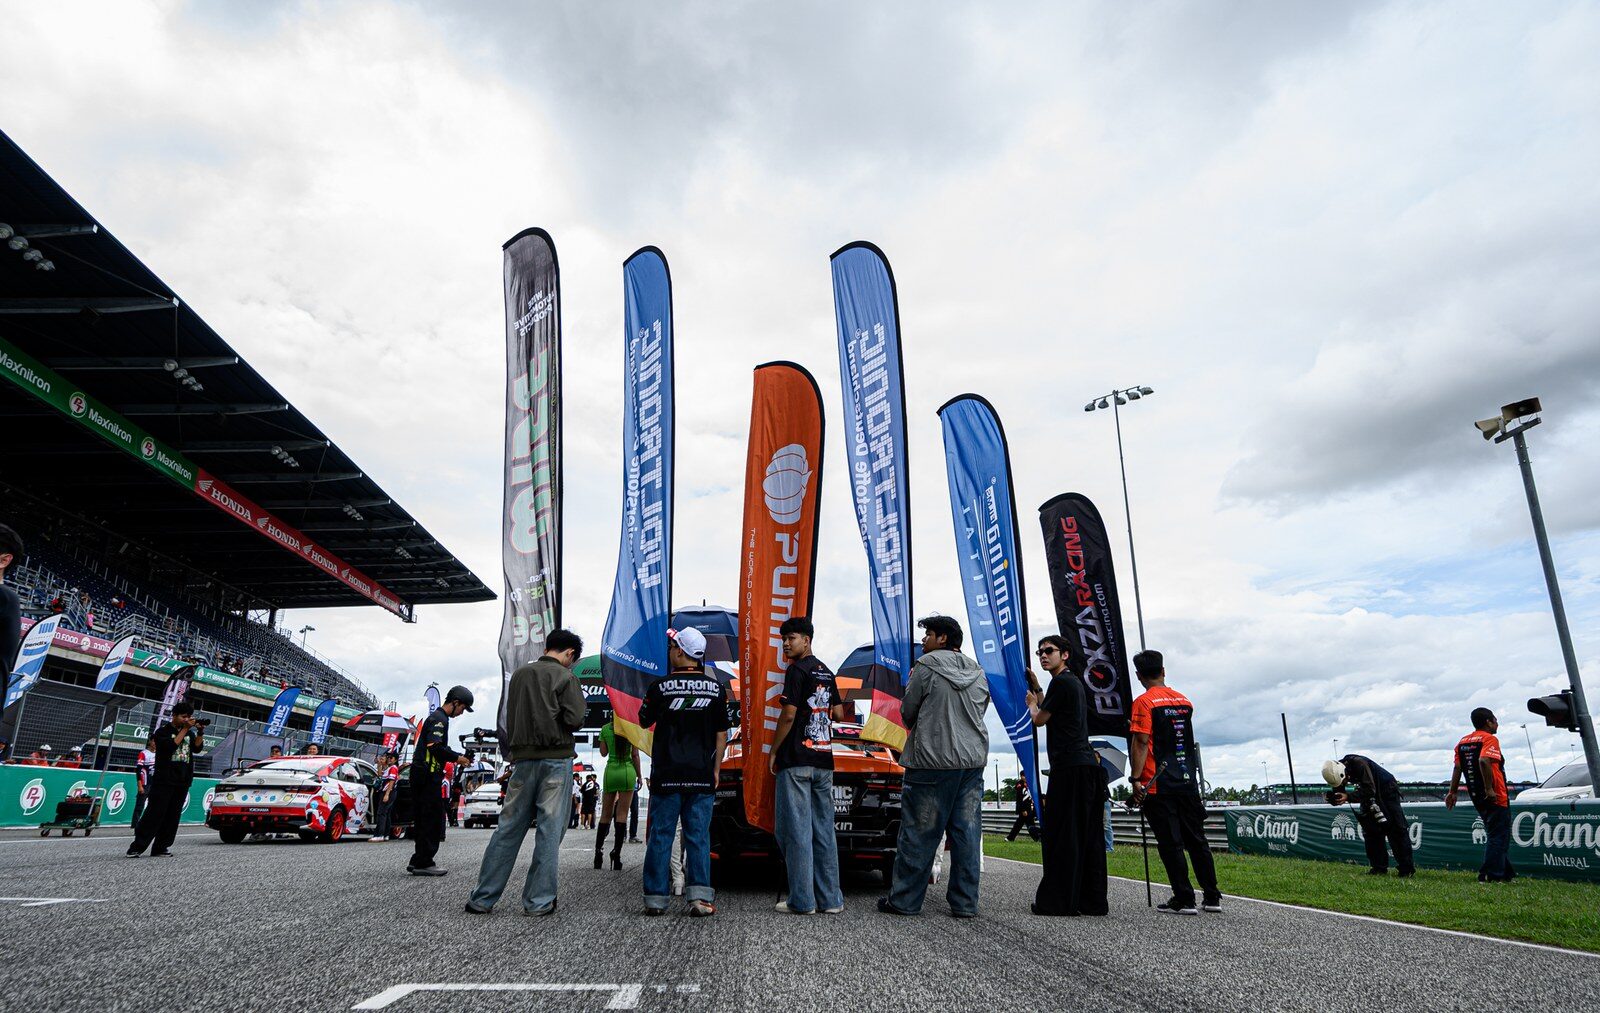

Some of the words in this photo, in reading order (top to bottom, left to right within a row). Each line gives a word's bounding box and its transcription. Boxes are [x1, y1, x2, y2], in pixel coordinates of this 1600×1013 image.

[0, 352, 50, 393] Maxnitron
[88, 408, 132, 443] Maxnitron
[157, 451, 192, 480] Maxnitron
[211, 487, 252, 521] HONDA
[268, 525, 300, 550] HONDA
[312, 552, 338, 574] HONDA
[349, 574, 371, 595] HONDA
[746, 592, 752, 607] OF
[658, 679, 720, 693] VOLTRONIC
[268, 704, 287, 736] RONIC
[312, 716, 327, 744] RONIC
[134, 727, 149, 738] Cha
[26, 787, 40, 807] PT
[111, 790, 122, 808] PT
[1254, 814, 1300, 845] Chang
[1543, 853, 1590, 870] MINERAL
